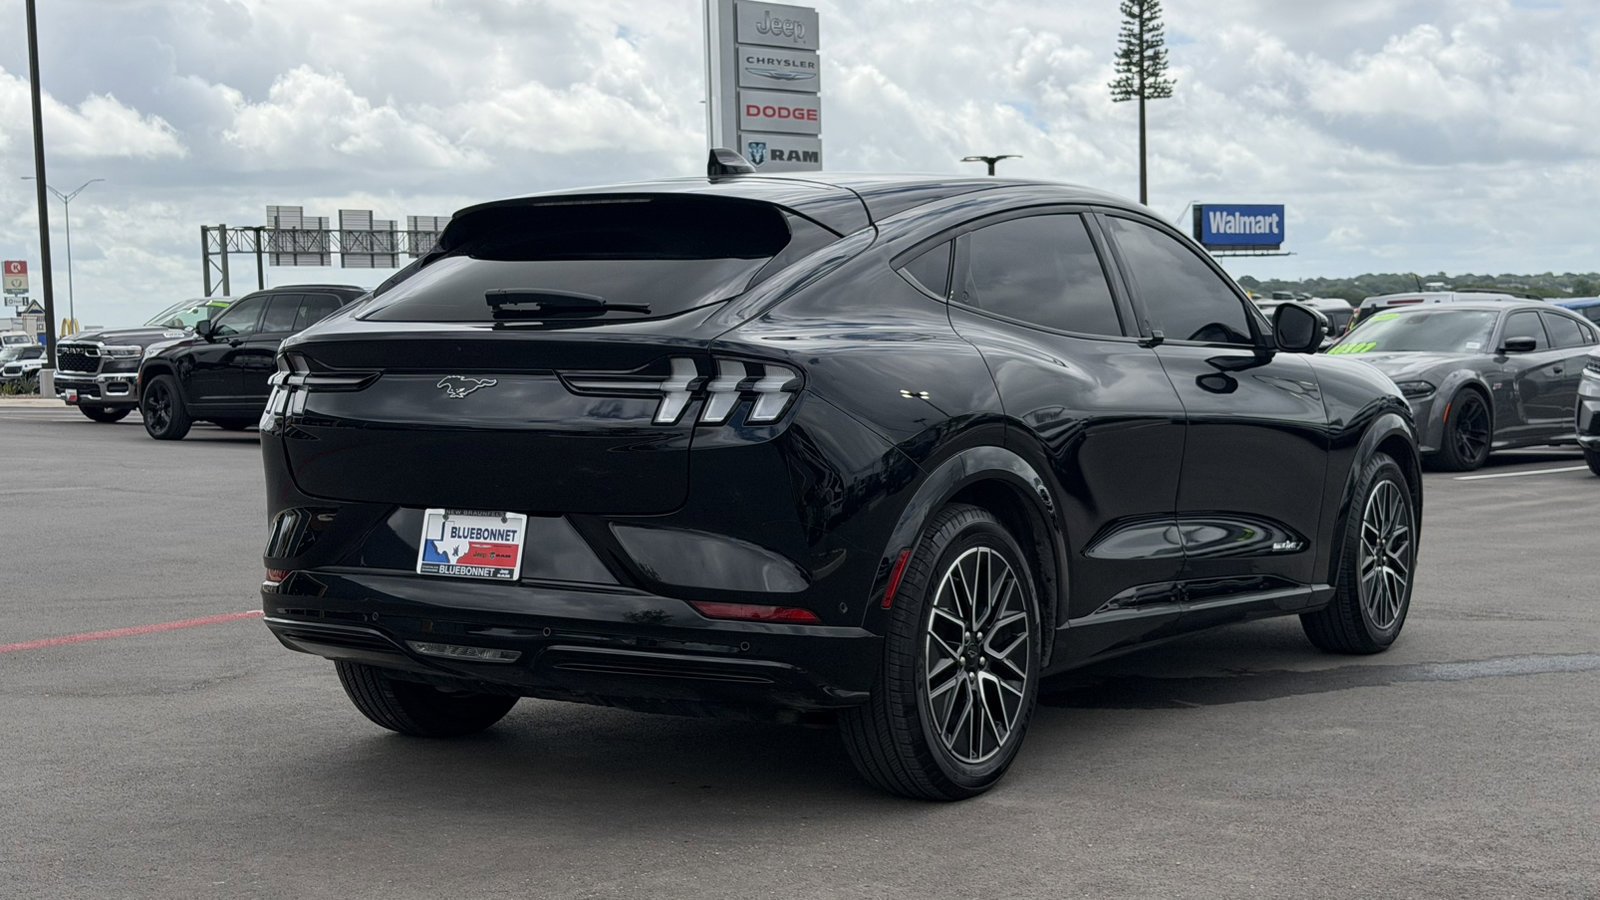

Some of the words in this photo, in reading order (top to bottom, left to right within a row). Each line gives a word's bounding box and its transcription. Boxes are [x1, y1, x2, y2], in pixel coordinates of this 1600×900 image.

[756, 10, 805, 43] Jeep
[746, 56, 815, 69] CHRYSLER
[746, 104, 818, 121] DODGE
[770, 149, 819, 163] RAM
[1208, 211, 1279, 234] Walmart
[450, 526, 517, 542] BLUEBONNET
[439, 565, 495, 577] BLUEBONNET
